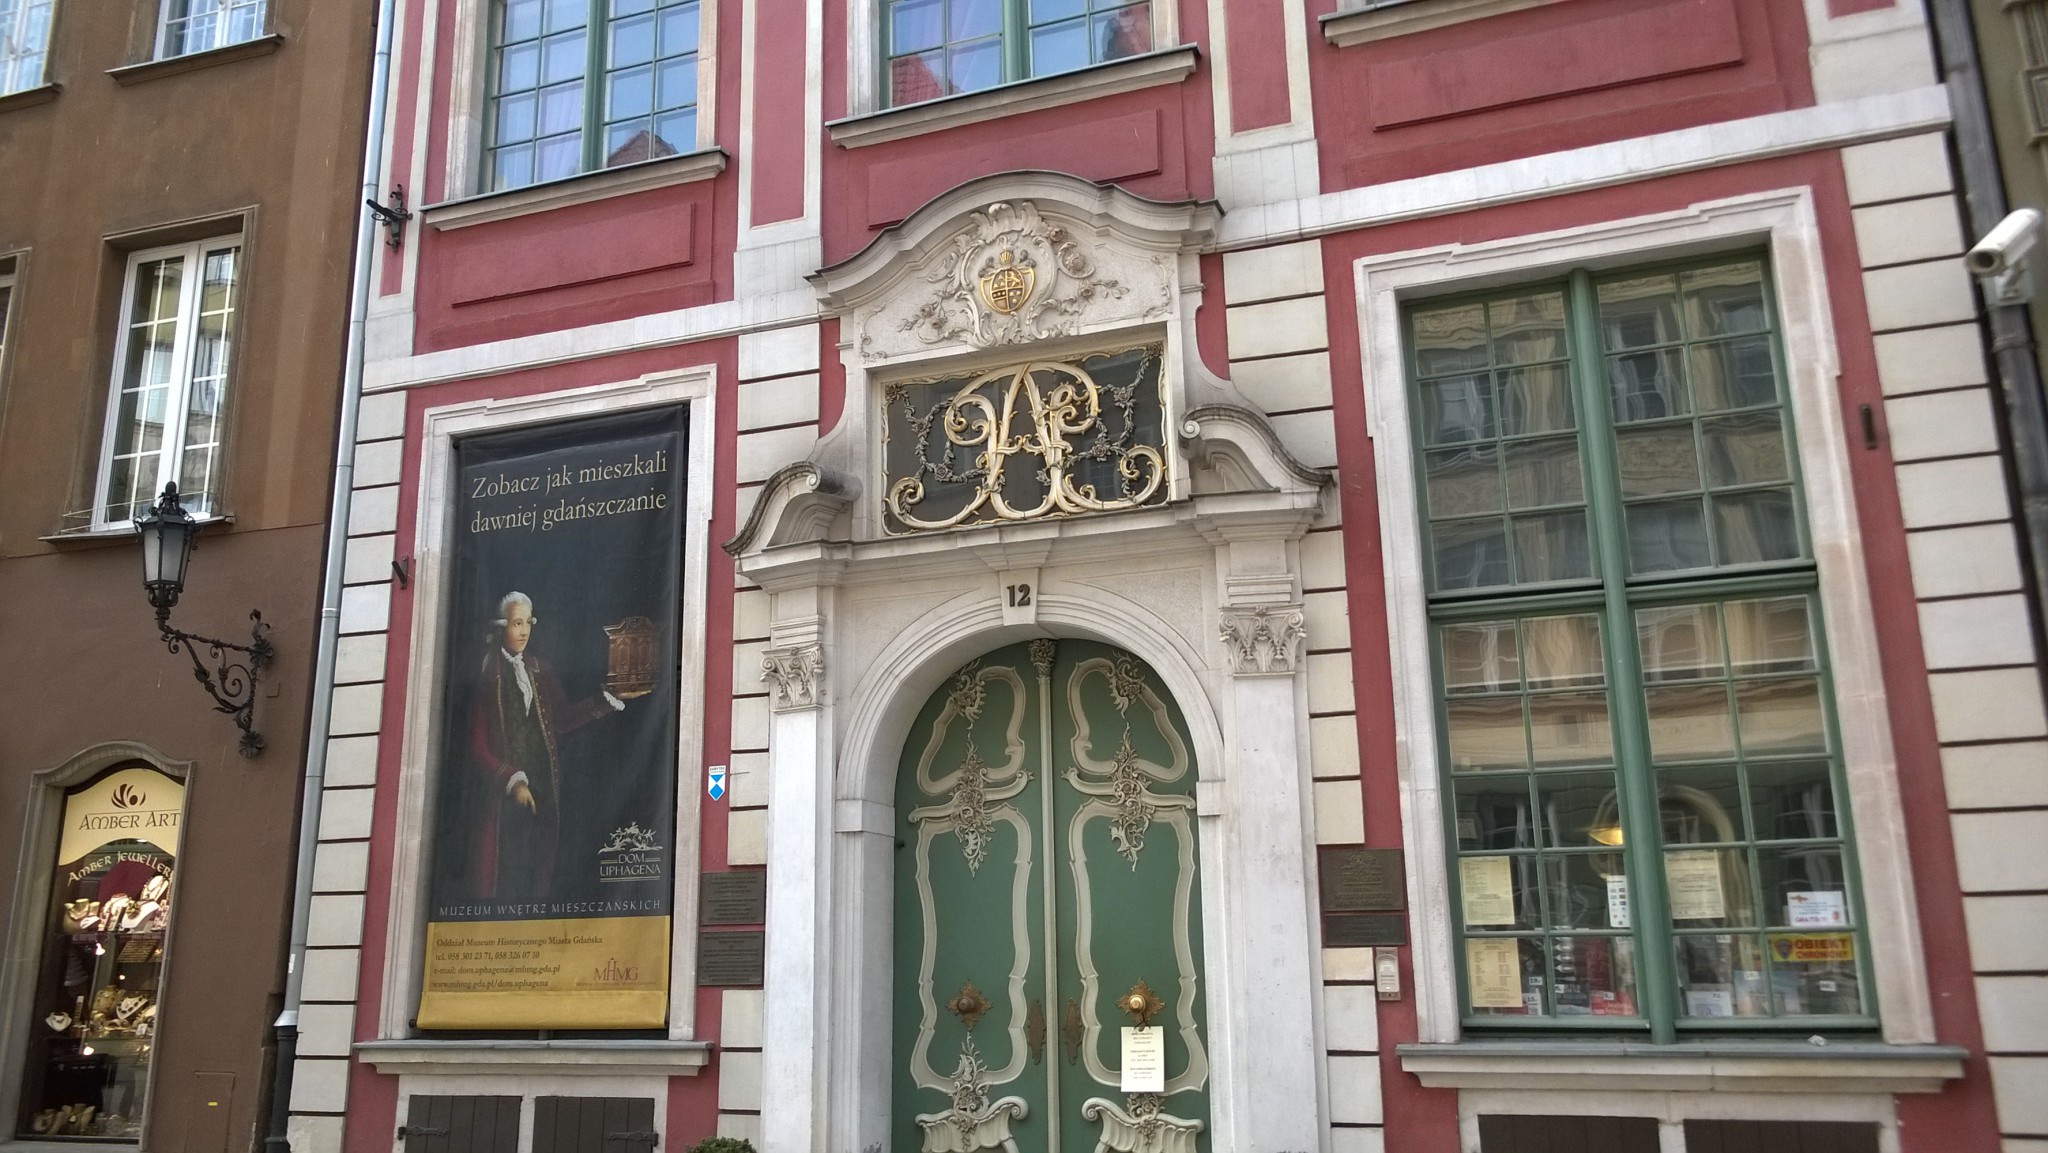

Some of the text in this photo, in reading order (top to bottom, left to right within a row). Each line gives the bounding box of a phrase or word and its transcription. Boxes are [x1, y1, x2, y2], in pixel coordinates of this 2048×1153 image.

[471, 450, 667, 498] Zobacz jak mieszkali
[471, 487, 667, 533] dawniej gdańszczanie
[1006, 583, 1031, 607] 12
[78, 811, 181, 830] AMBER ART
[618, 852, 645, 864] DOM
[600, 863, 661, 876] UPHAGENA
[439, 899, 660, 917] MUZEUM WNĘTRZ MIESZCZAŃSKICH
[466, 938, 496, 947] Muzeum
[496, 937, 547, 948] Historycznego
[548, 936, 572, 945] Miasta
[1795, 938, 1848, 950] OBIEKT
[593, 960, 639, 981] MHMG
